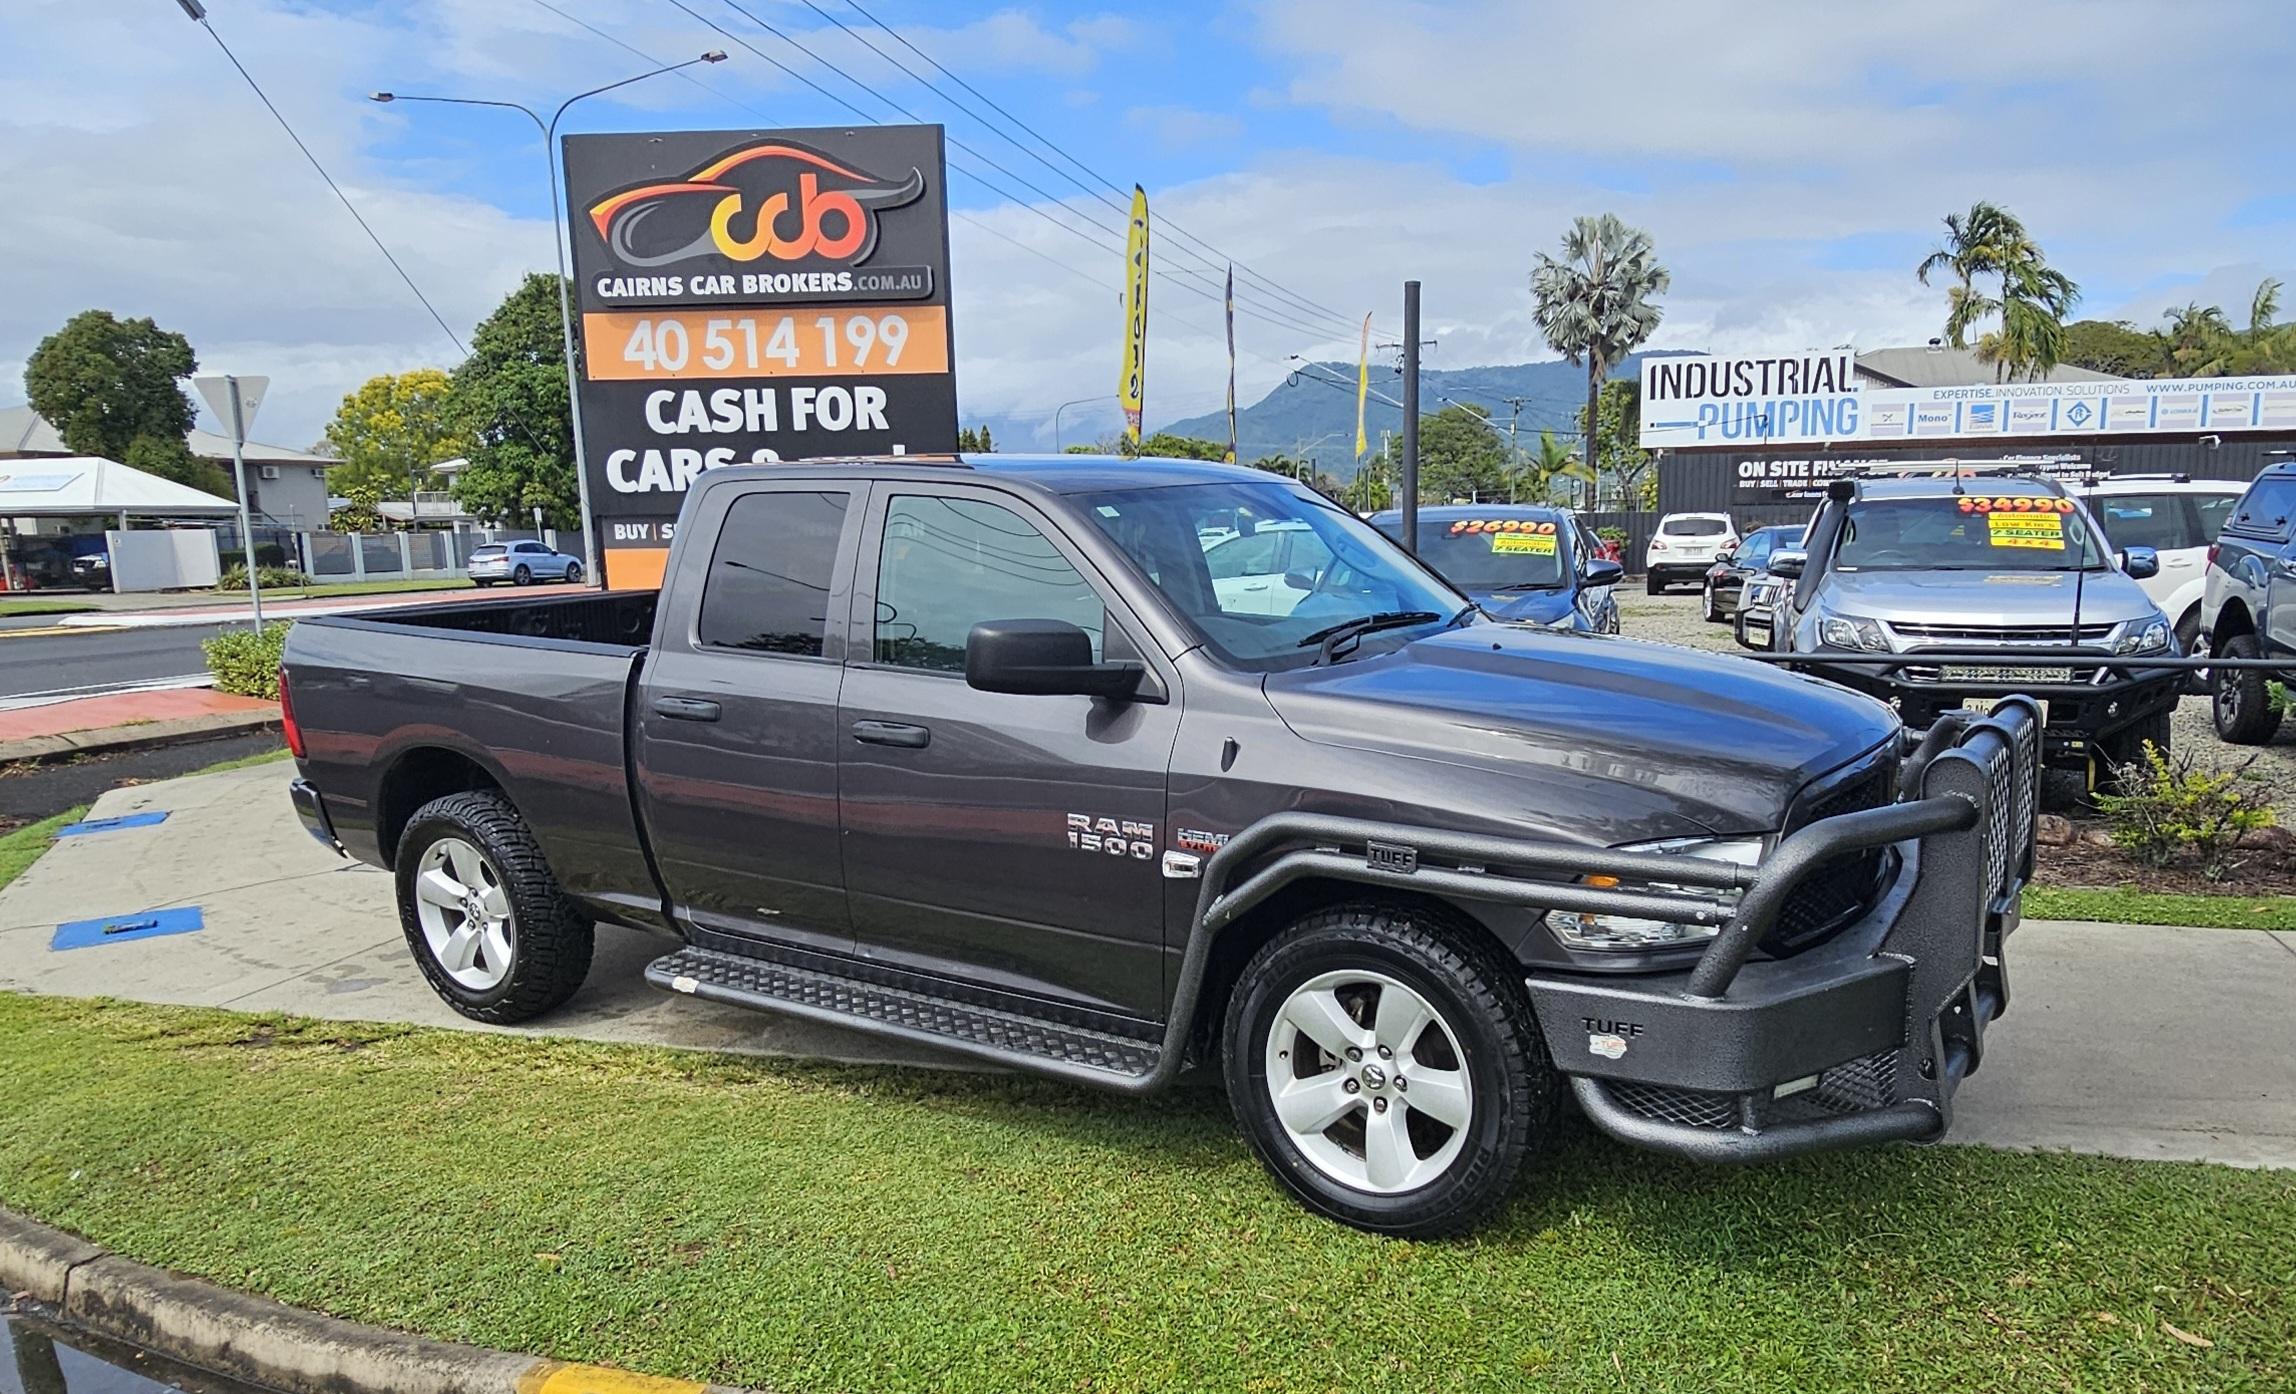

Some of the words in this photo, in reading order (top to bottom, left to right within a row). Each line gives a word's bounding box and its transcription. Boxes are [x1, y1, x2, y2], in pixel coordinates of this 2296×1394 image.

[597, 275, 683, 298] CAIRNS
[691, 275, 734, 295] CAR
[624, 320, 689, 371] 40
[702, 317, 800, 370] 514
[816, 315, 909, 367] 199
[1649, 355, 1853, 400] INDUSTRIAL
[646, 388, 778, 434] CASH
[791, 386, 890, 431] FOR
[1697, 397, 1858, 440] PUMPING
[1918, 414, 1948, 423] Mono
[1738, 460, 1766, 478] ON
[1769, 460, 1810, 477] SITE
[1760, 480, 1778, 488] SELL
[1957, 497, 2076, 514] $34990
[614, 523, 649, 540] BUY
[1450, 520, 1556, 535] $26990
[1067, 813, 1153, 841] RAM
[1067, 831, 1153, 861] 1500
[1371, 848, 1413, 866] TUFF
[1581, 1017, 1644, 1038] TUFF
